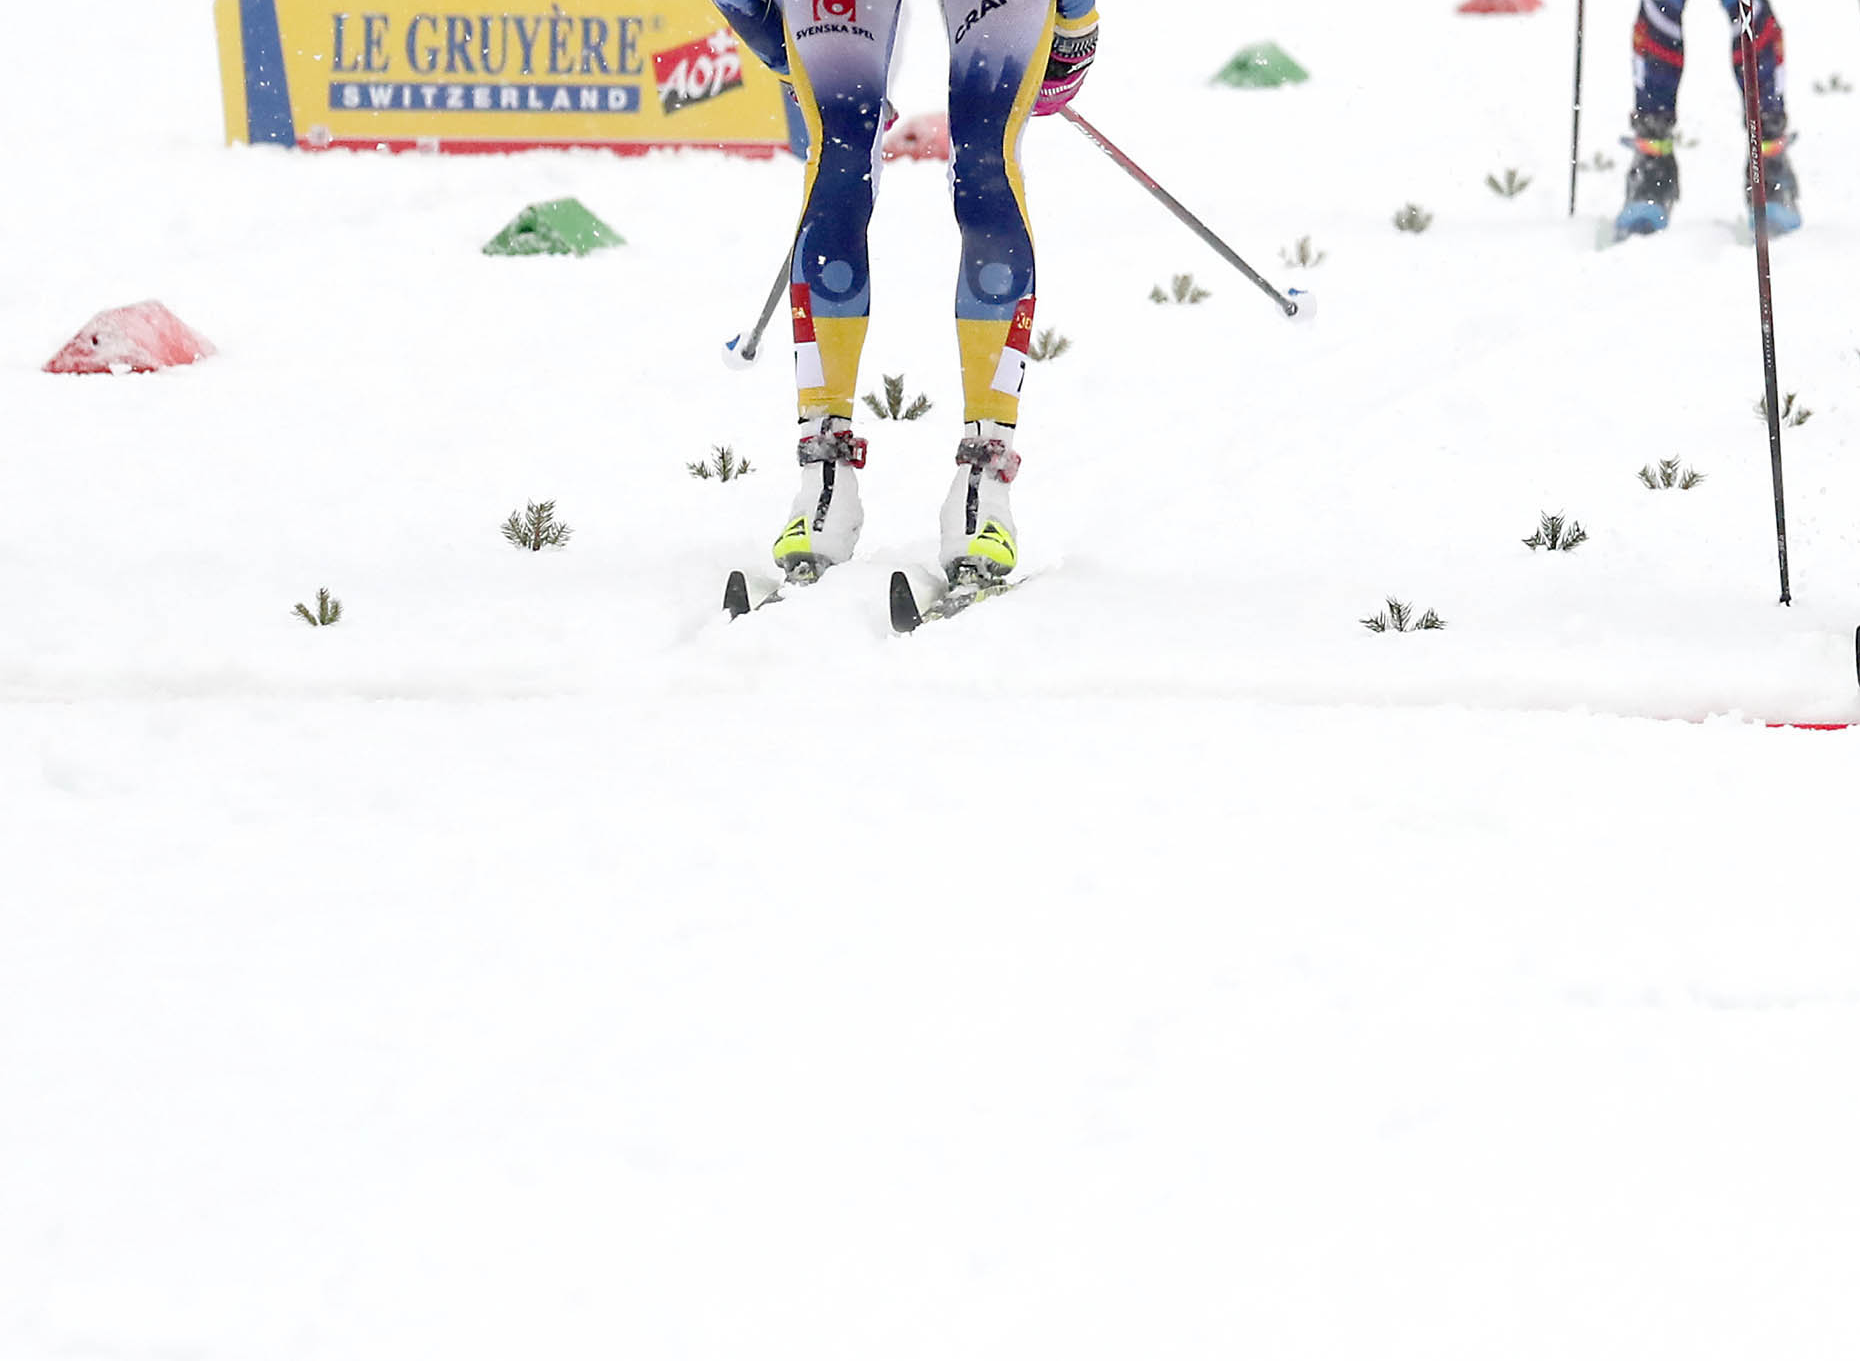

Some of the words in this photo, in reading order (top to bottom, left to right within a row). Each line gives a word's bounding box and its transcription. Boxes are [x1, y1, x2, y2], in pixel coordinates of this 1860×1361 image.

[330, 12, 391, 74] LE
[406, 3, 646, 76] GRUYÈRE
[796, 23, 849, 41] SVENSKA
[851, 25, 876, 41] SPEL
[657, 53, 743, 103] AOP
[342, 87, 629, 111] SWITZERLAND
